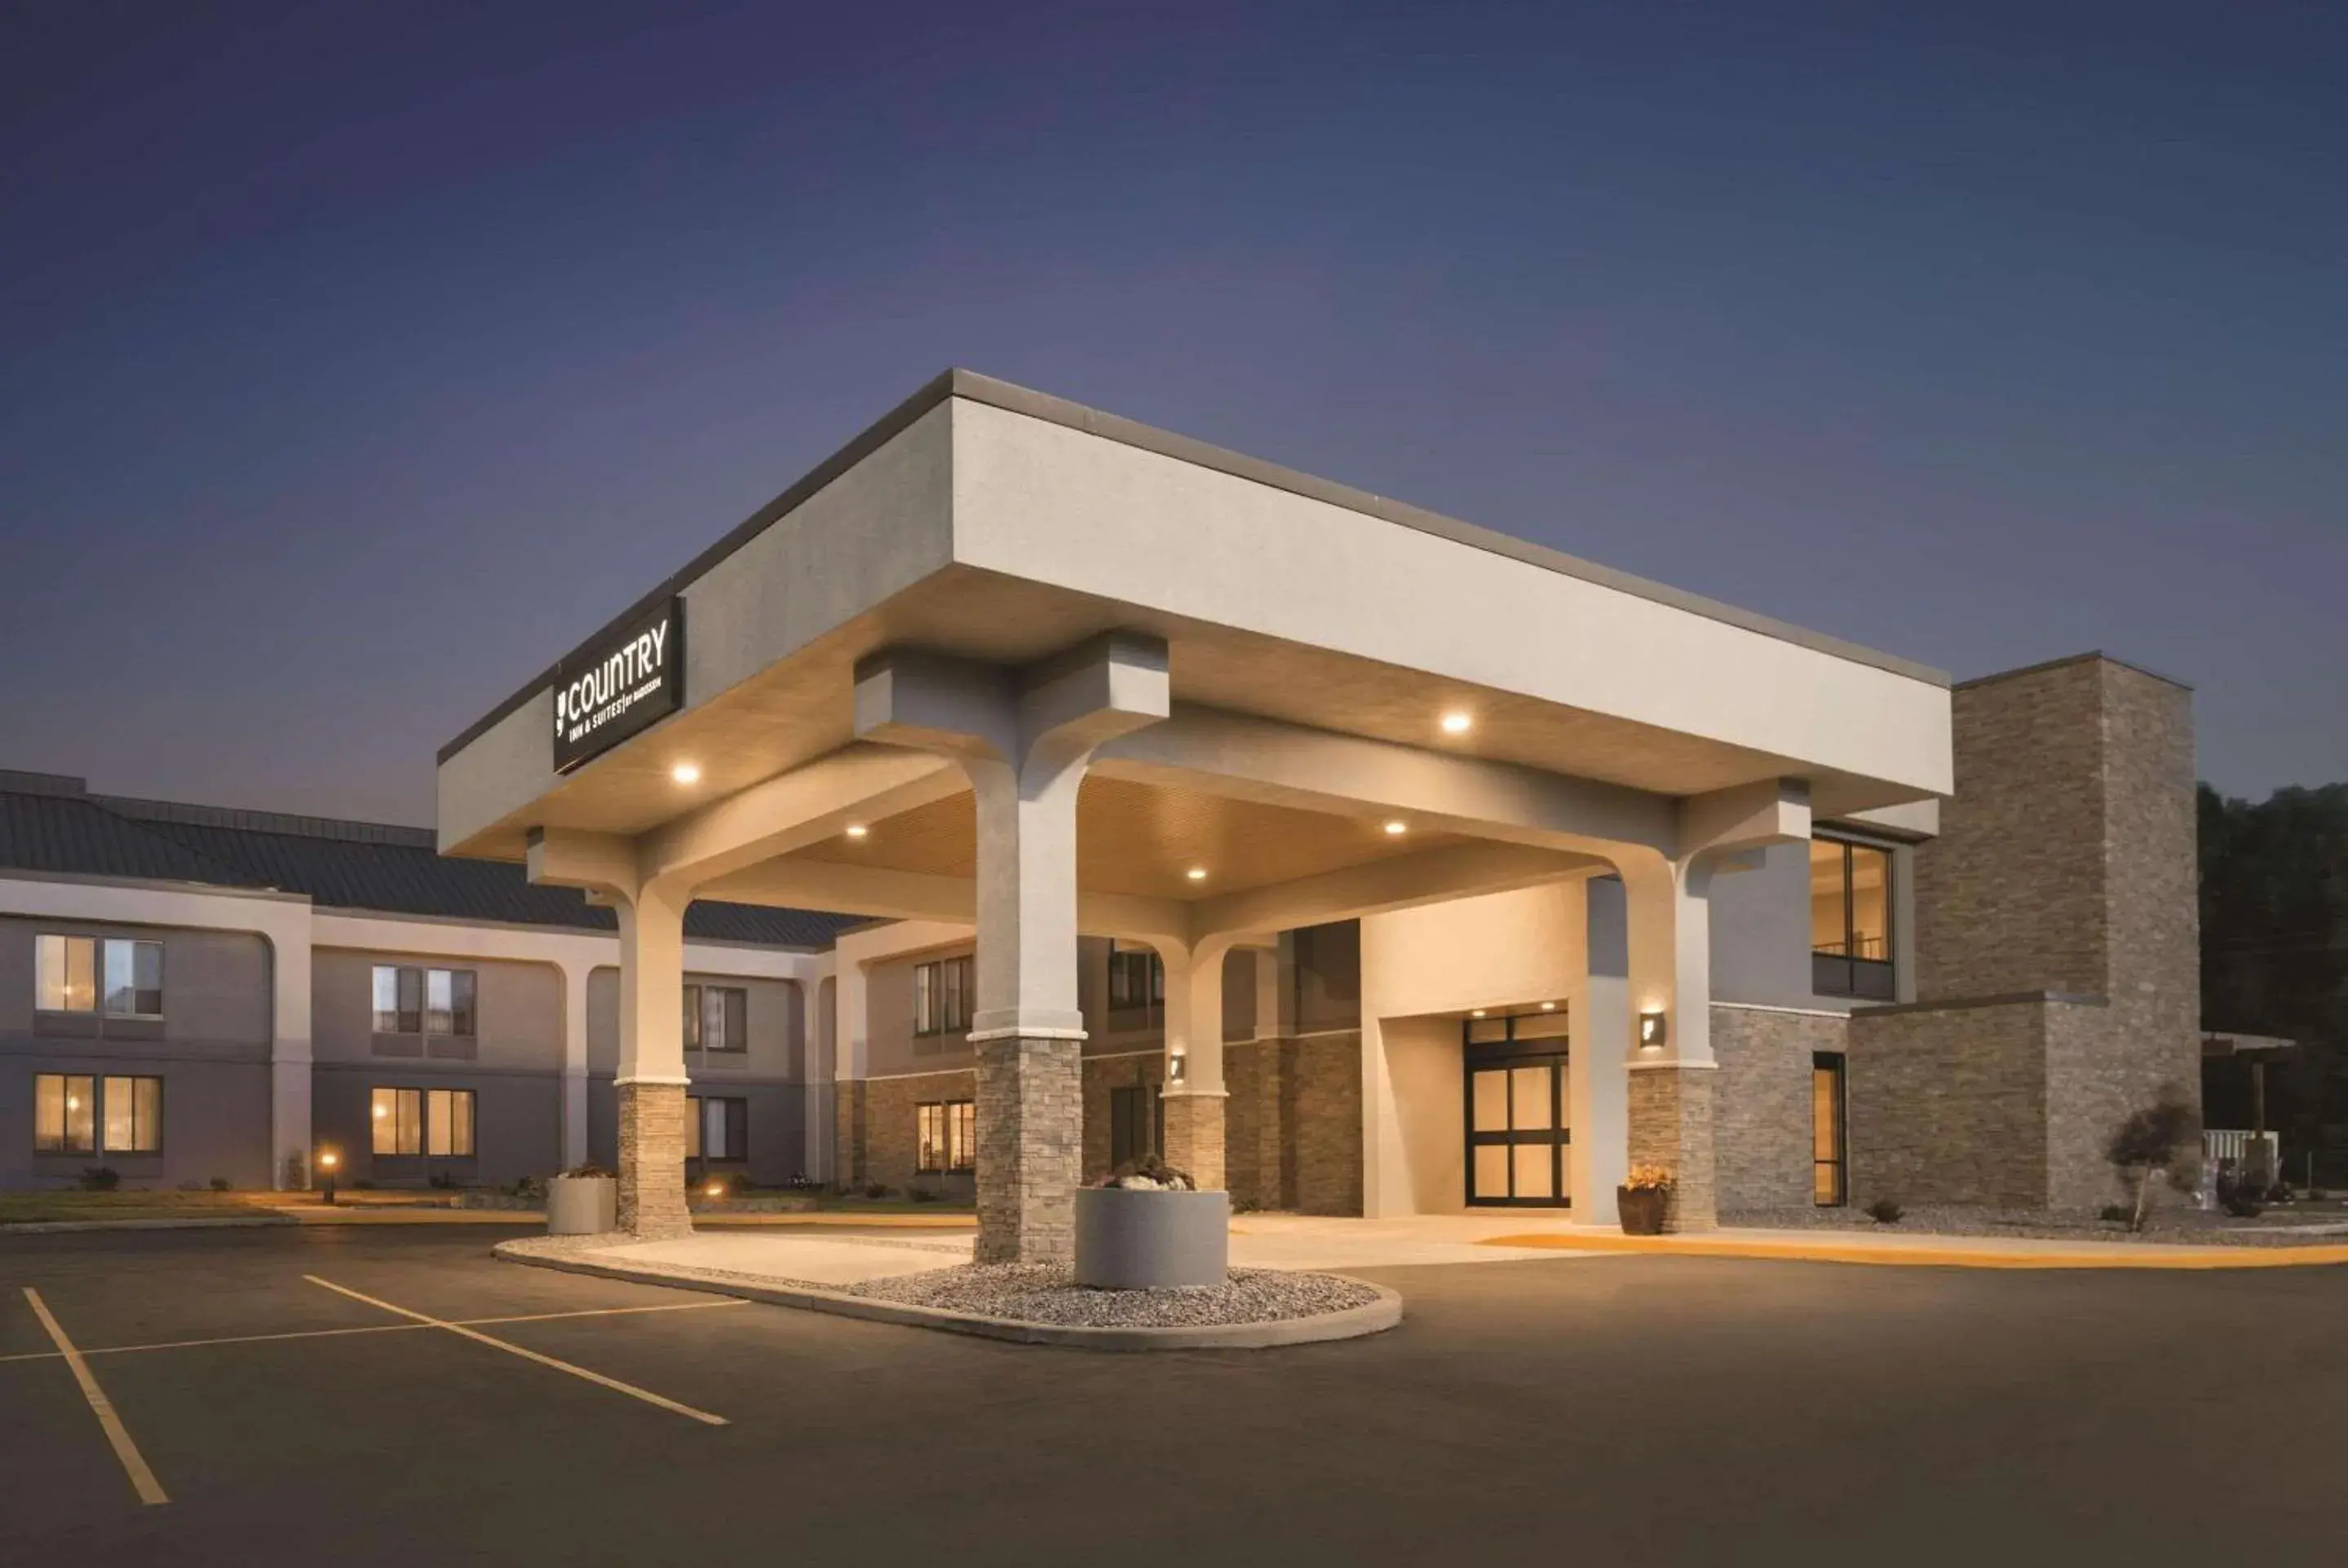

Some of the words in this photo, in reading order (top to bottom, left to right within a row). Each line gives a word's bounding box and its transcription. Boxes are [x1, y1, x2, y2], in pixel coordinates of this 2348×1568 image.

[568, 619, 668, 722] COUNTRY
[569, 723, 582, 743] INN
[585, 719, 590, 733] &
[592, 699, 621, 729] SUITES
